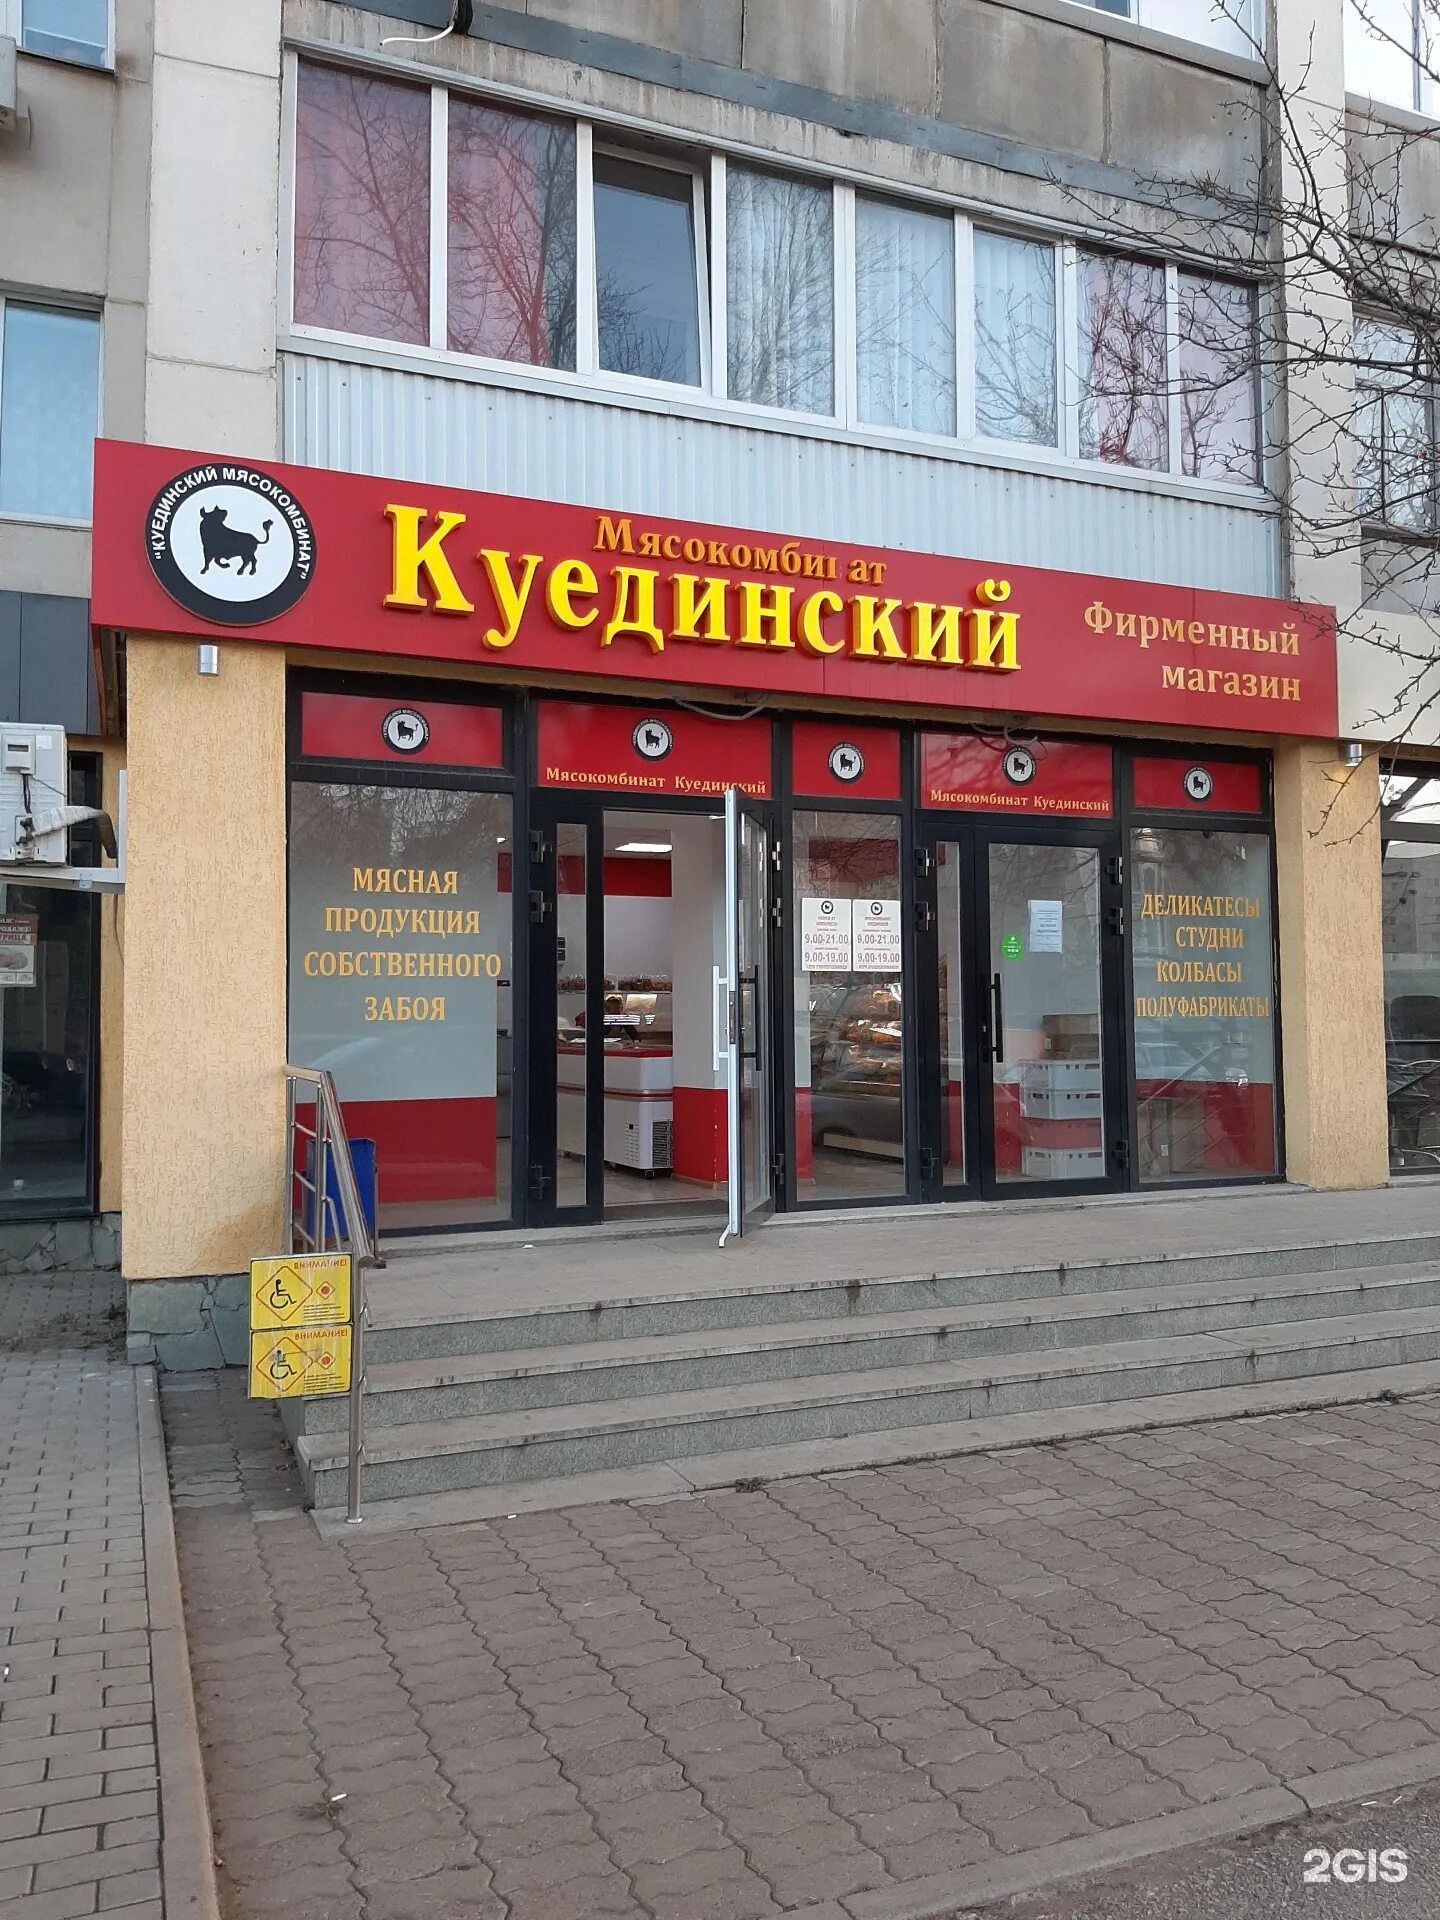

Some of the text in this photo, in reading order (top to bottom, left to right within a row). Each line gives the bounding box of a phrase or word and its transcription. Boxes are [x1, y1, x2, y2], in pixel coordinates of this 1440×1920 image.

[382, 503, 1022, 673] Куединский
[1084, 600, 1300, 656] Фирменный
[1161, 665, 1301, 701] магазин
[546, 767, 666, 788] Мясокомбинат
[931, 789, 1109, 812] Мясокомбинат Куединский
[353, 867, 459, 895] МЯСНАЯ
[1141, 894, 1261, 920] ДЕЛИКАТЕСЫ
[325, 907, 480, 939] ПРОДУКЦИЯ
[804, 933, 849, 945] 9.00-21.00
[1175, 926, 1245, 952] СТУДНИ
[304, 951, 501, 977] СОБСТВЕННОГО
[804, 952, 849, 963] 9.00-19.00
[1156, 961, 1243, 983] КОЛБАСЫ
[364, 996, 446, 1021] ЗАБОЯ
[1136, 996, 1270, 1018] ПОЛУФАБРИКАТЫ
